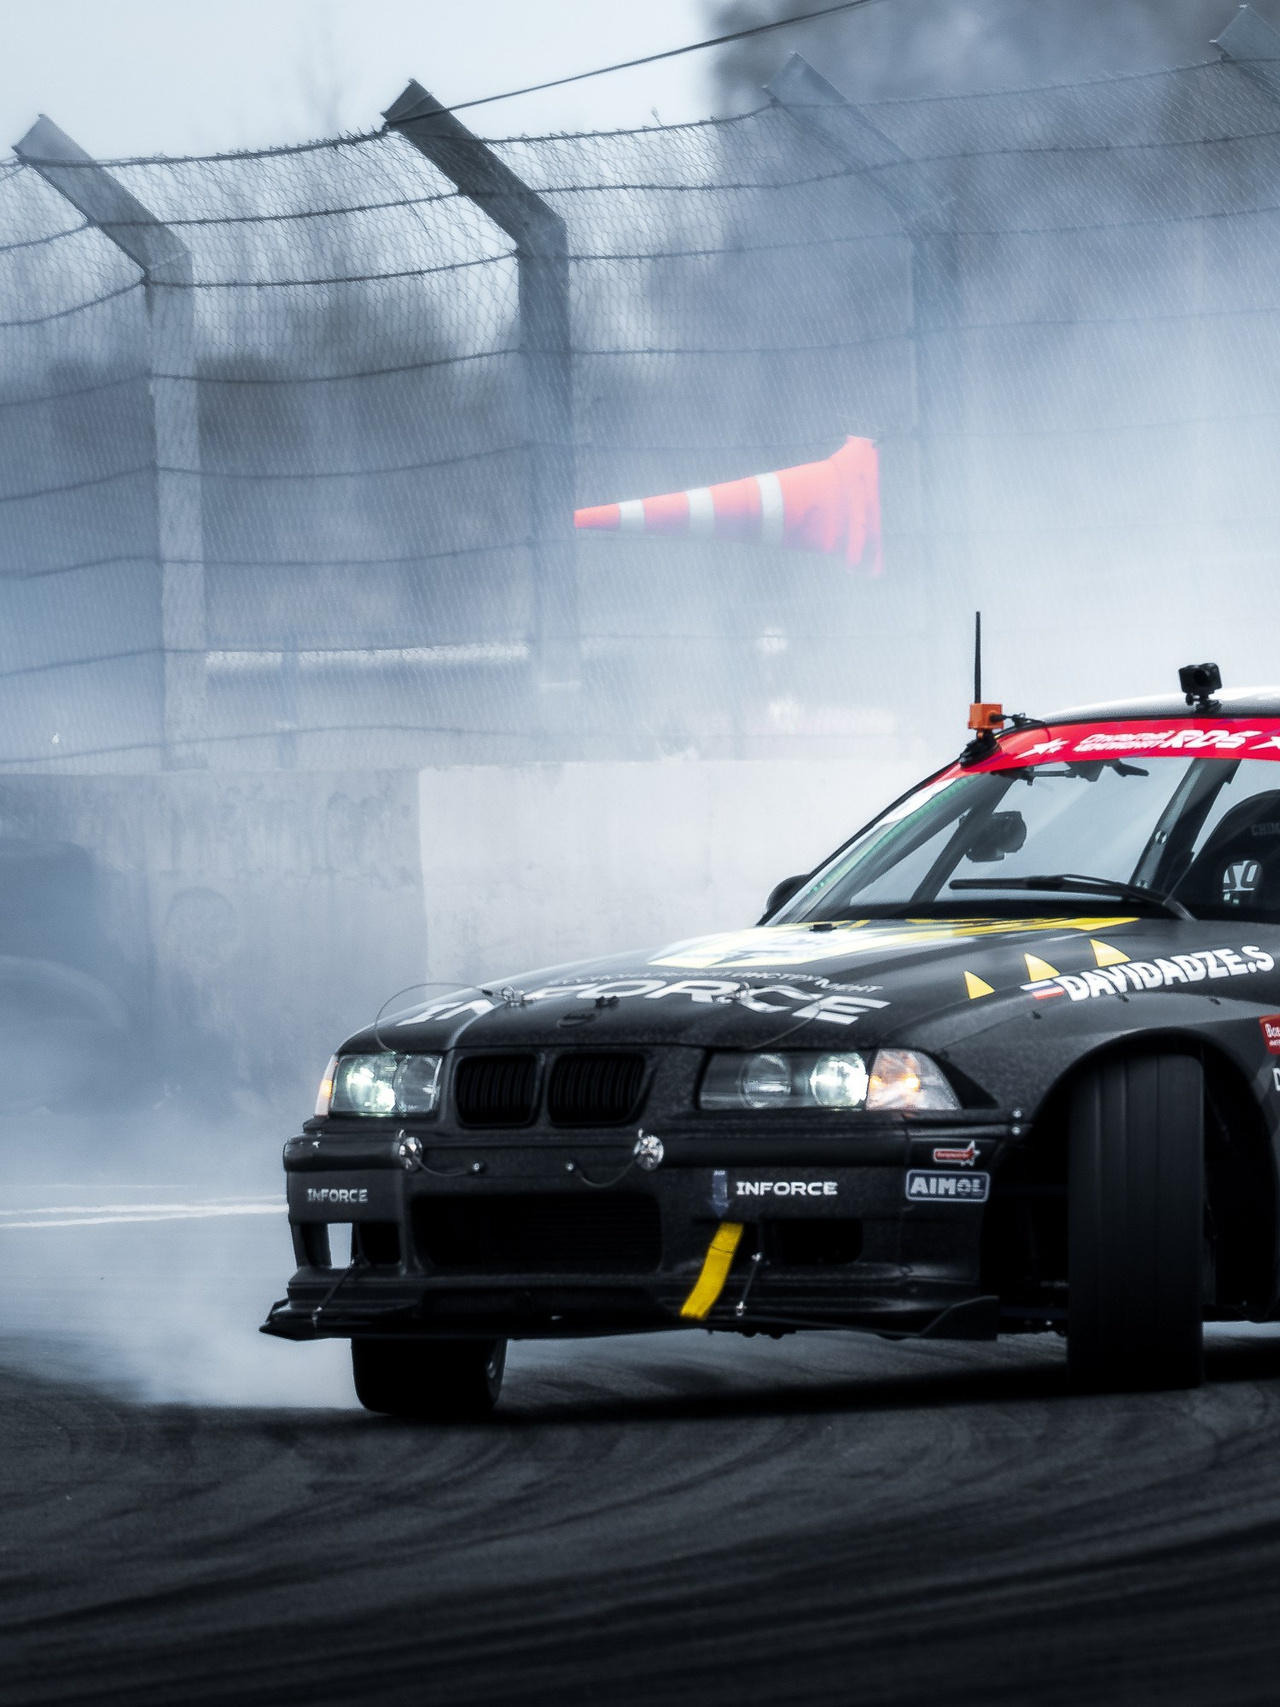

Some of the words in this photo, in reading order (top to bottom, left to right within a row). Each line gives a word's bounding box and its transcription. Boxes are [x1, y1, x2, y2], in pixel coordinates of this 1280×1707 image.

[1160, 729, 1262, 749] RDS
[1054, 945, 1275, 1001] DAVIDADZE.S
[307, 1188, 368, 1203] INFORCE
[736, 1181, 838, 1196] INFORCE
[909, 1176, 986, 1196] AIMOL
